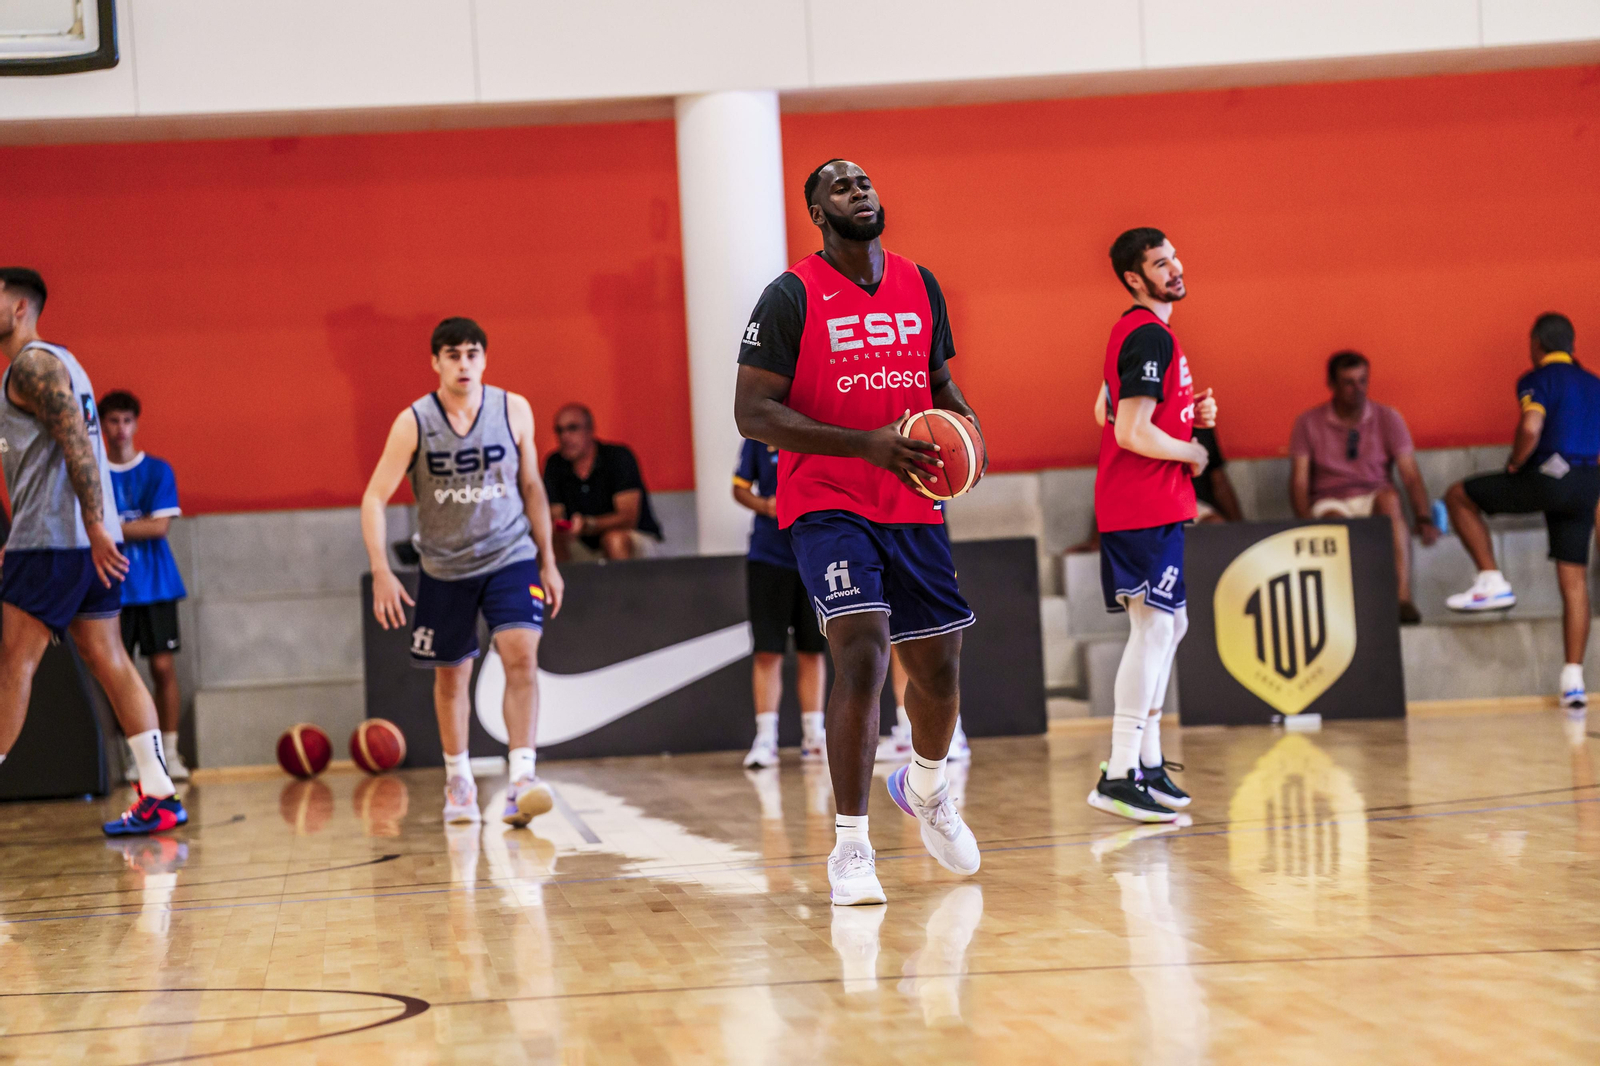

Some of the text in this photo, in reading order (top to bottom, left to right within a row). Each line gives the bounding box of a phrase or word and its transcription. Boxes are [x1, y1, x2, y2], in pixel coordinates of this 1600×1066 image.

[826, 312, 922, 352] ESP
[829, 350, 927, 365] BASKETBALL
[836, 366, 927, 393] endesa
[426, 444, 506, 476] ESP
[1294, 537, 1337, 556] FEB
[825, 586, 861, 601] network
